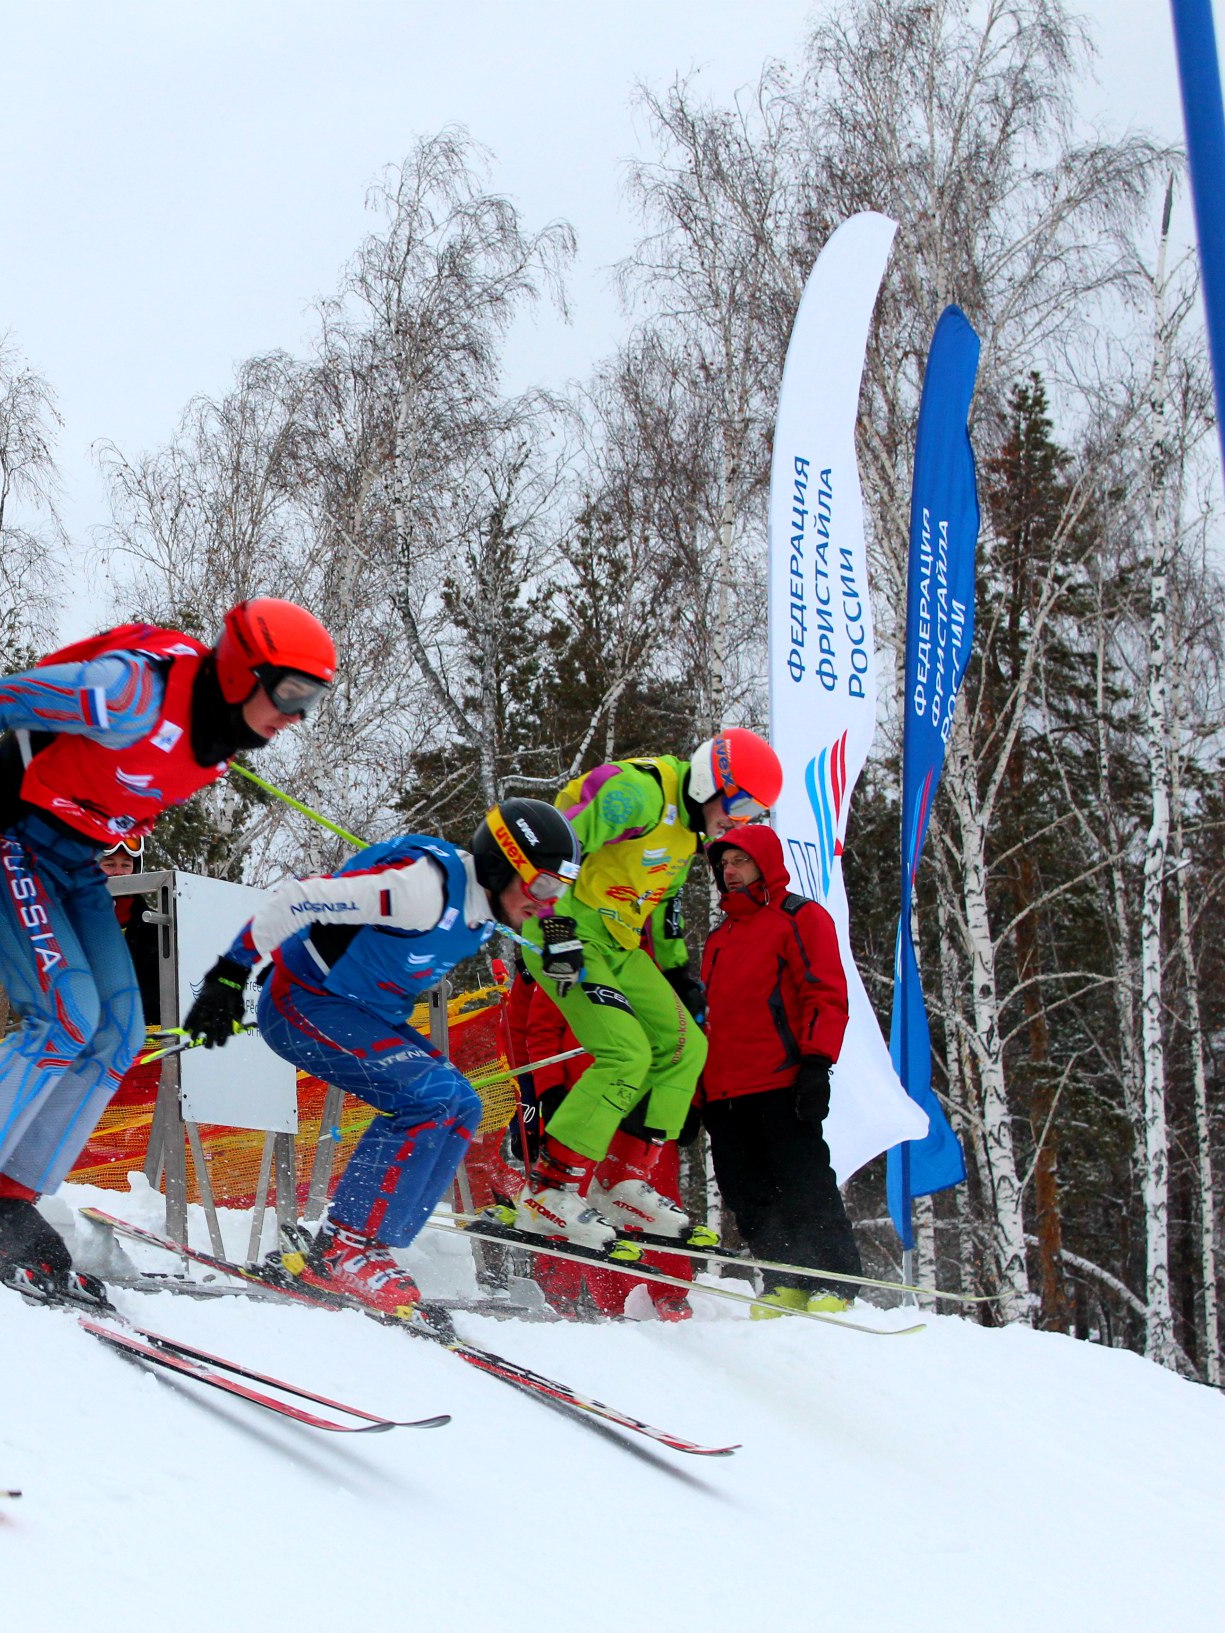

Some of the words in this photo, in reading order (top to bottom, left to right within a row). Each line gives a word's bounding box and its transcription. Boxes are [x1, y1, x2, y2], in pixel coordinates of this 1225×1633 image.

[787, 456, 810, 683] ФЕДЕРАЦИЯ
[814, 468, 838, 692] ФРИСТАЙЛА
[839, 547, 868, 698] РОССИИ
[914, 507, 934, 716] ФЕДЕРАЦИЯ
[931, 520, 949, 727] ФРИСТАЙЛА
[940, 598, 966, 744] РОССИИ
[494, 826, 528, 869] uvex
[516, 818, 540, 847] uvex
[524, 1198, 568, 1228] ATOMIC
[612, 1200, 656, 1223] ATOMIC
